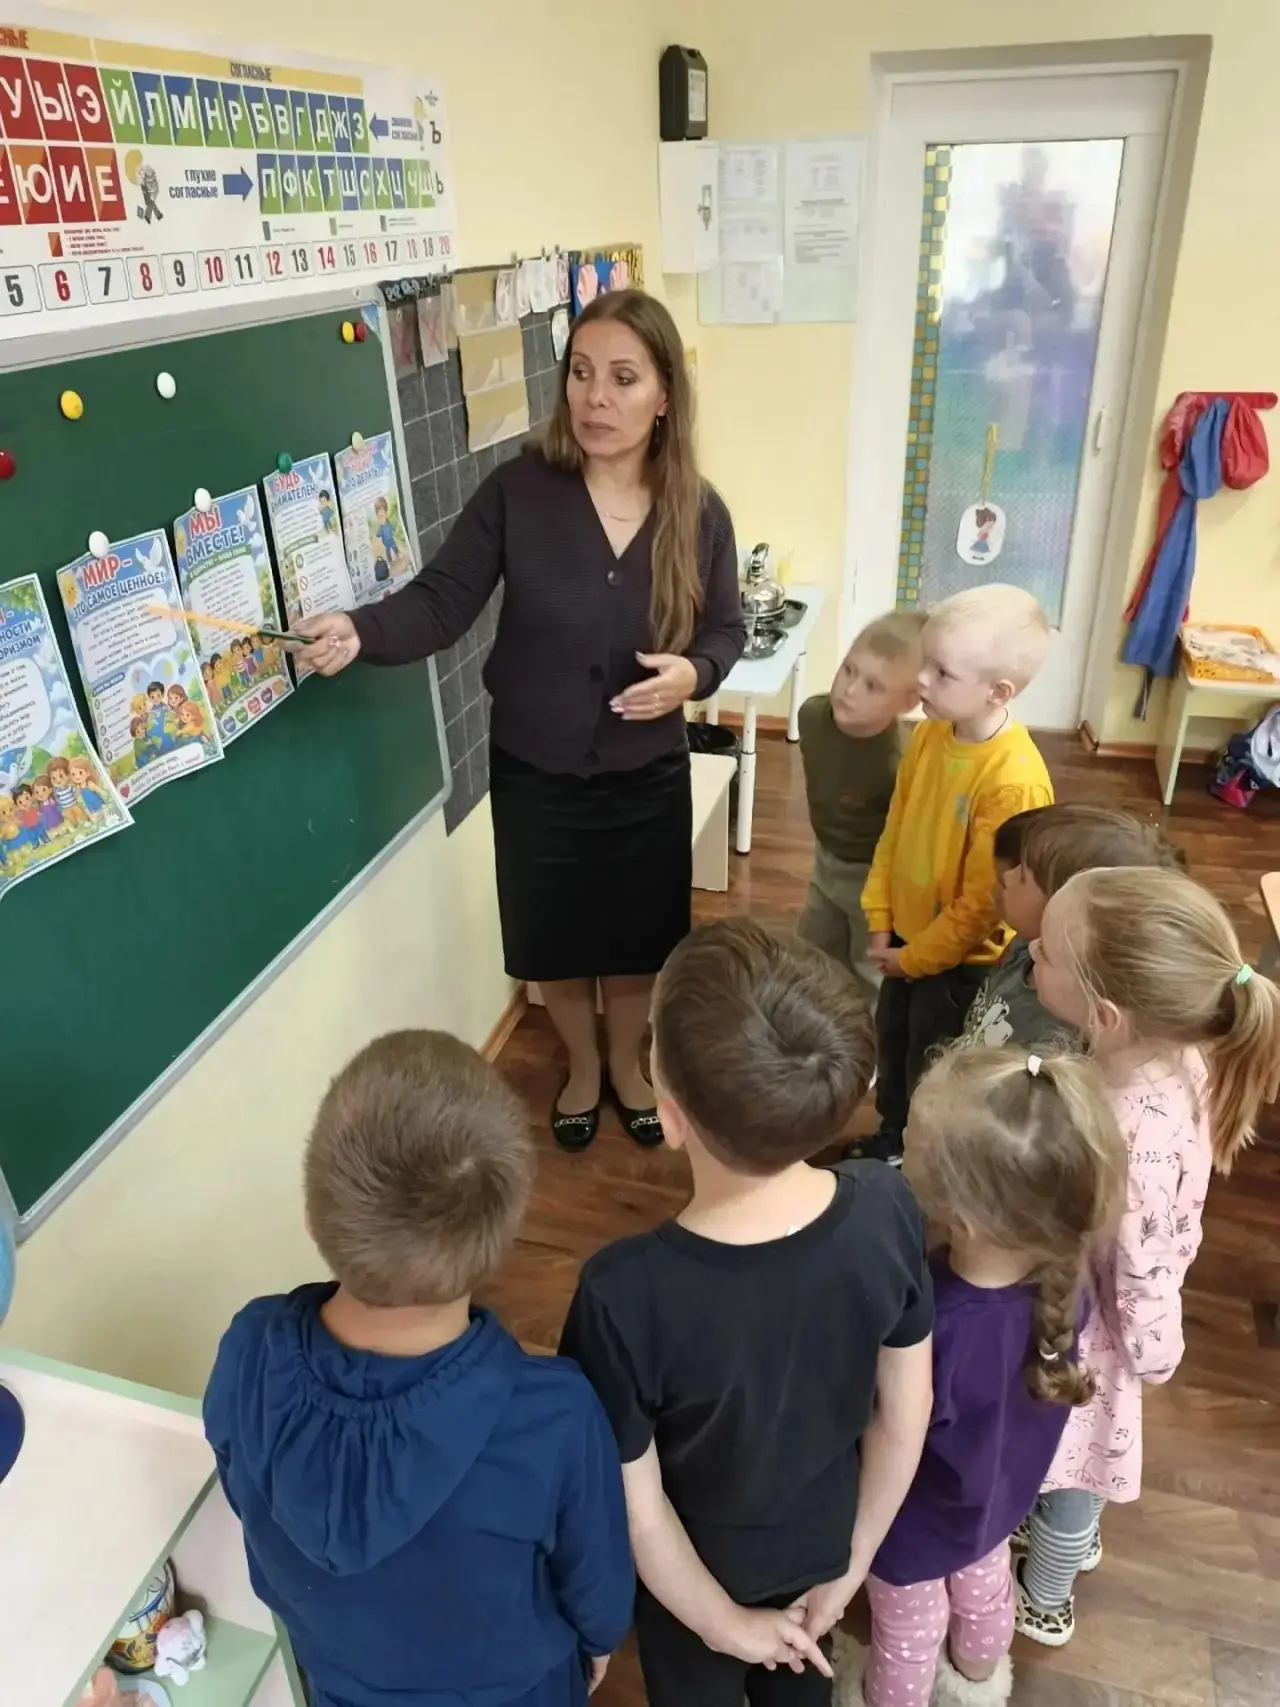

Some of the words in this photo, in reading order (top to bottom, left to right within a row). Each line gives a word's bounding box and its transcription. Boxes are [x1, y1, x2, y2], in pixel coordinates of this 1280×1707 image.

[0, 76, 21, 118] У
[34, 80, 72, 121] Ы
[77, 84, 101, 123] Э
[110, 78, 135, 126] Й
[144, 91, 165, 128] Л
[170, 94, 197, 130] М
[204, 96, 224, 132] Н
[228, 100, 243, 133] Р
[250, 102, 269, 134] Б
[274, 104, 290, 135] В
[295, 107, 304, 137] Г
[315, 109, 331, 144] Д
[331, 110, 349, 139] Ж
[353, 112, 365, 140] З
[429, 120, 442, 144] Ъ
[15, 163, 53, 204] Ю
[60, 164, 86, 203] И
[95, 165, 118, 202] Е
[169, 186, 218, 199] согласные
[261, 168, 276, 199] П
[283, 168, 298, 198] Ф
[302, 169, 317, 197] К
[323, 169, 335, 197] Т
[339, 169, 357, 197] Ш
[360, 169, 370, 197] С
[375, 169, 389, 196] Х
[390, 170, 404, 201] Ц
[407, 170, 418, 195] Ч
[435, 172, 444, 195] Ь
[5, 274, 24, 307] 5
[54, 269, 71, 302] 6
[98, 266, 111, 296] 7
[139, 262, 153, 292] 8
[173, 259, 186, 287] 9
[205, 256, 224, 283] 10
[235, 253, 253, 280] 11
[266, 250, 282, 276] 12
[291, 248, 309, 272] 13
[317, 246, 335, 270] 14
[343, 244, 356, 267] 15
[363, 242, 378, 264] 16
[385, 240, 398, 262] 17
[407, 238, 418, 260] 18
[422, 237, 434, 257] 19
[439, 235, 451, 255] 20
[190, 506, 221, 540] МЫ
[186, 525, 245, 567] ВМЕСТЕ!
[87, 587, 117, 608] САМОЕ
[120, 571, 165, 594] ЦЕННОЕ!
